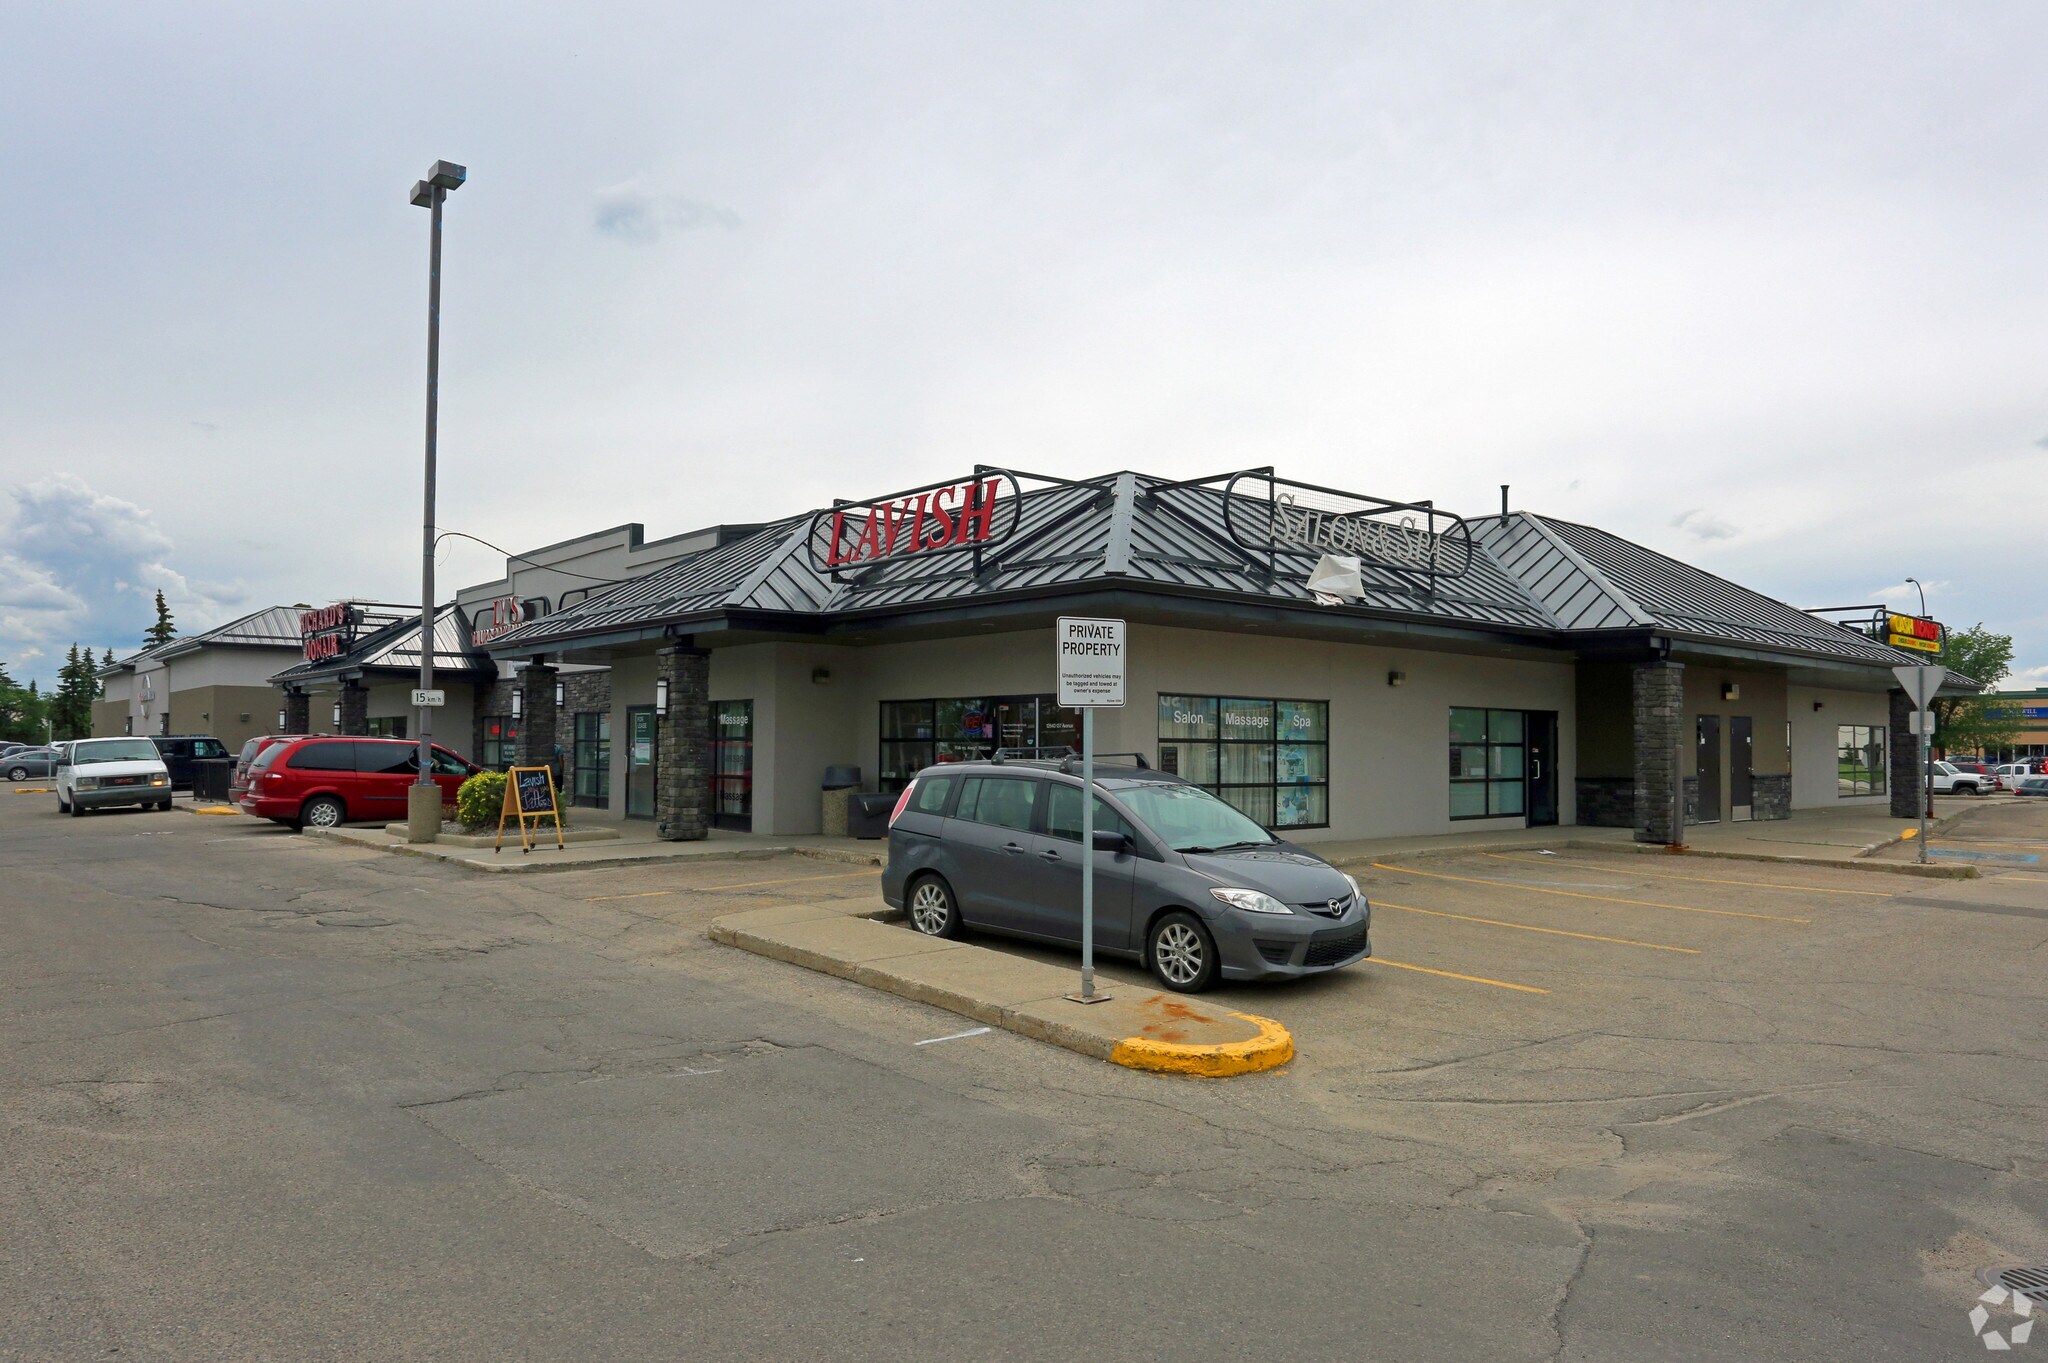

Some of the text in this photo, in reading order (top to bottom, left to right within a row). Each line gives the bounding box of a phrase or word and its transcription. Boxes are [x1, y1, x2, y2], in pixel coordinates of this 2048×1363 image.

[825, 478, 1002, 566] LAVISH
[1069, 624, 1114, 639] PRIVATE
[303, 633, 338, 660] DONAIR
[1062, 641, 1121, 656] PROPERTY
[415, 692, 426, 703] 15
[720, 713, 749, 726] Massage
[1173, 710, 1311, 730] Salon Massage Spa
